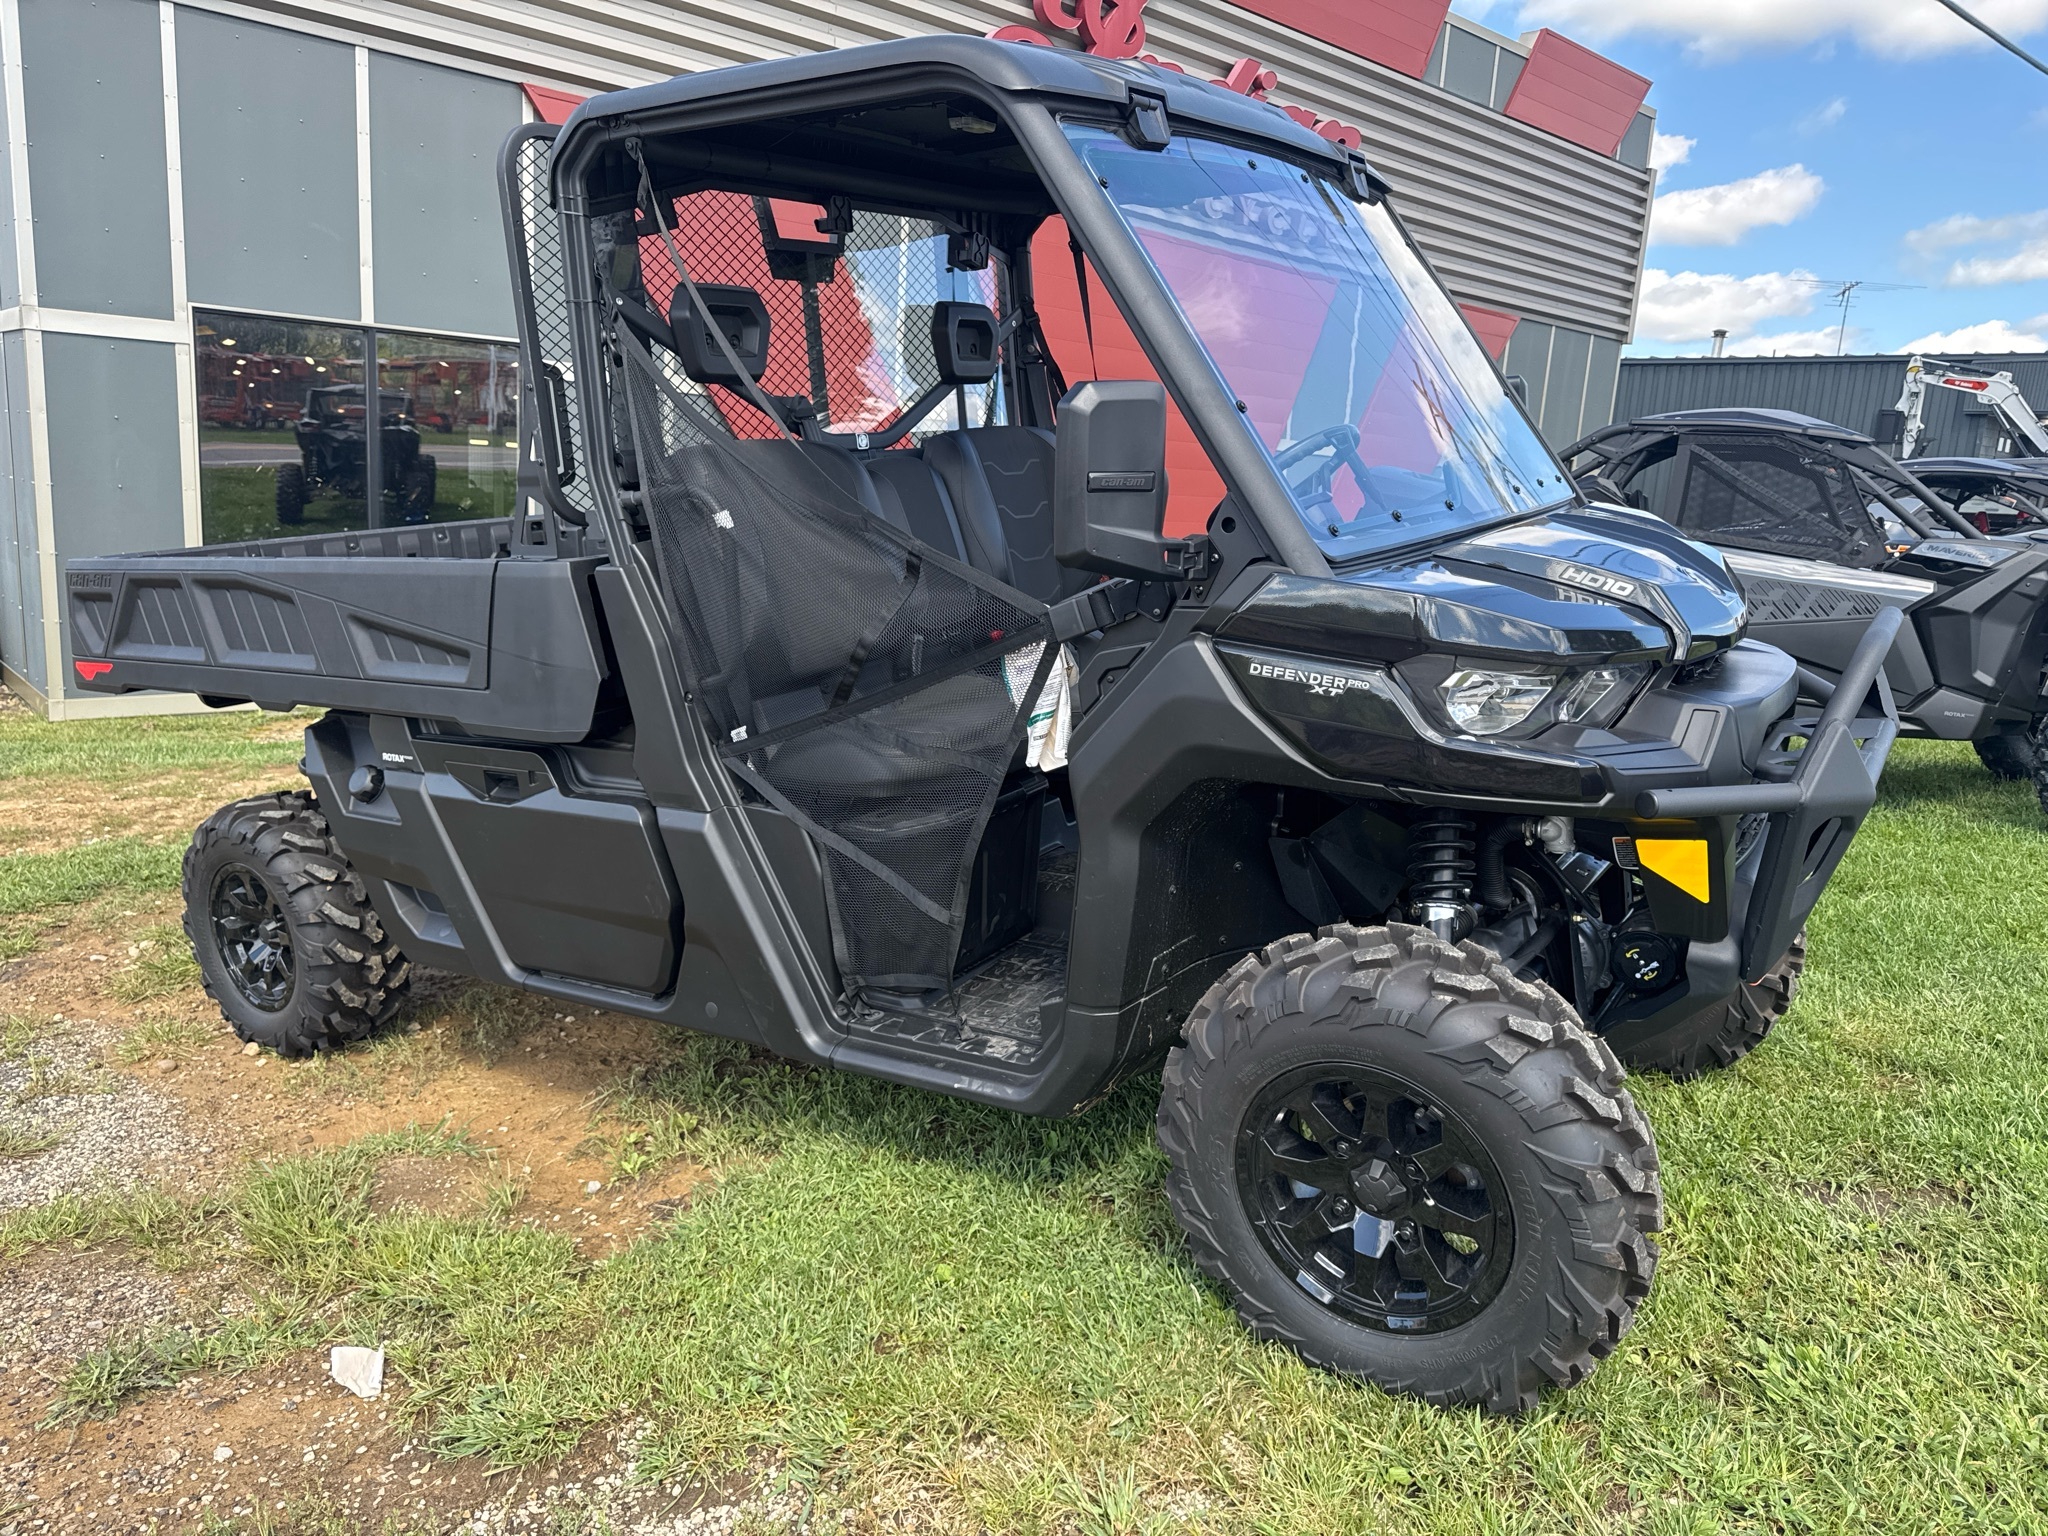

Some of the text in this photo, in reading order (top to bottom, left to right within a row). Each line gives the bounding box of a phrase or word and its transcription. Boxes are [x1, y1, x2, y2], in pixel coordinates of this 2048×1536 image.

[1100, 477, 1146, 487] can-am
[1562, 567, 1635, 597] HD10
[1248, 662, 1371, 690] DEFENDER PRO
[1308, 684, 1344, 697] XT
[1943, 710, 1966, 718] ROTAX
[382, 752, 405, 763] ROTAX
